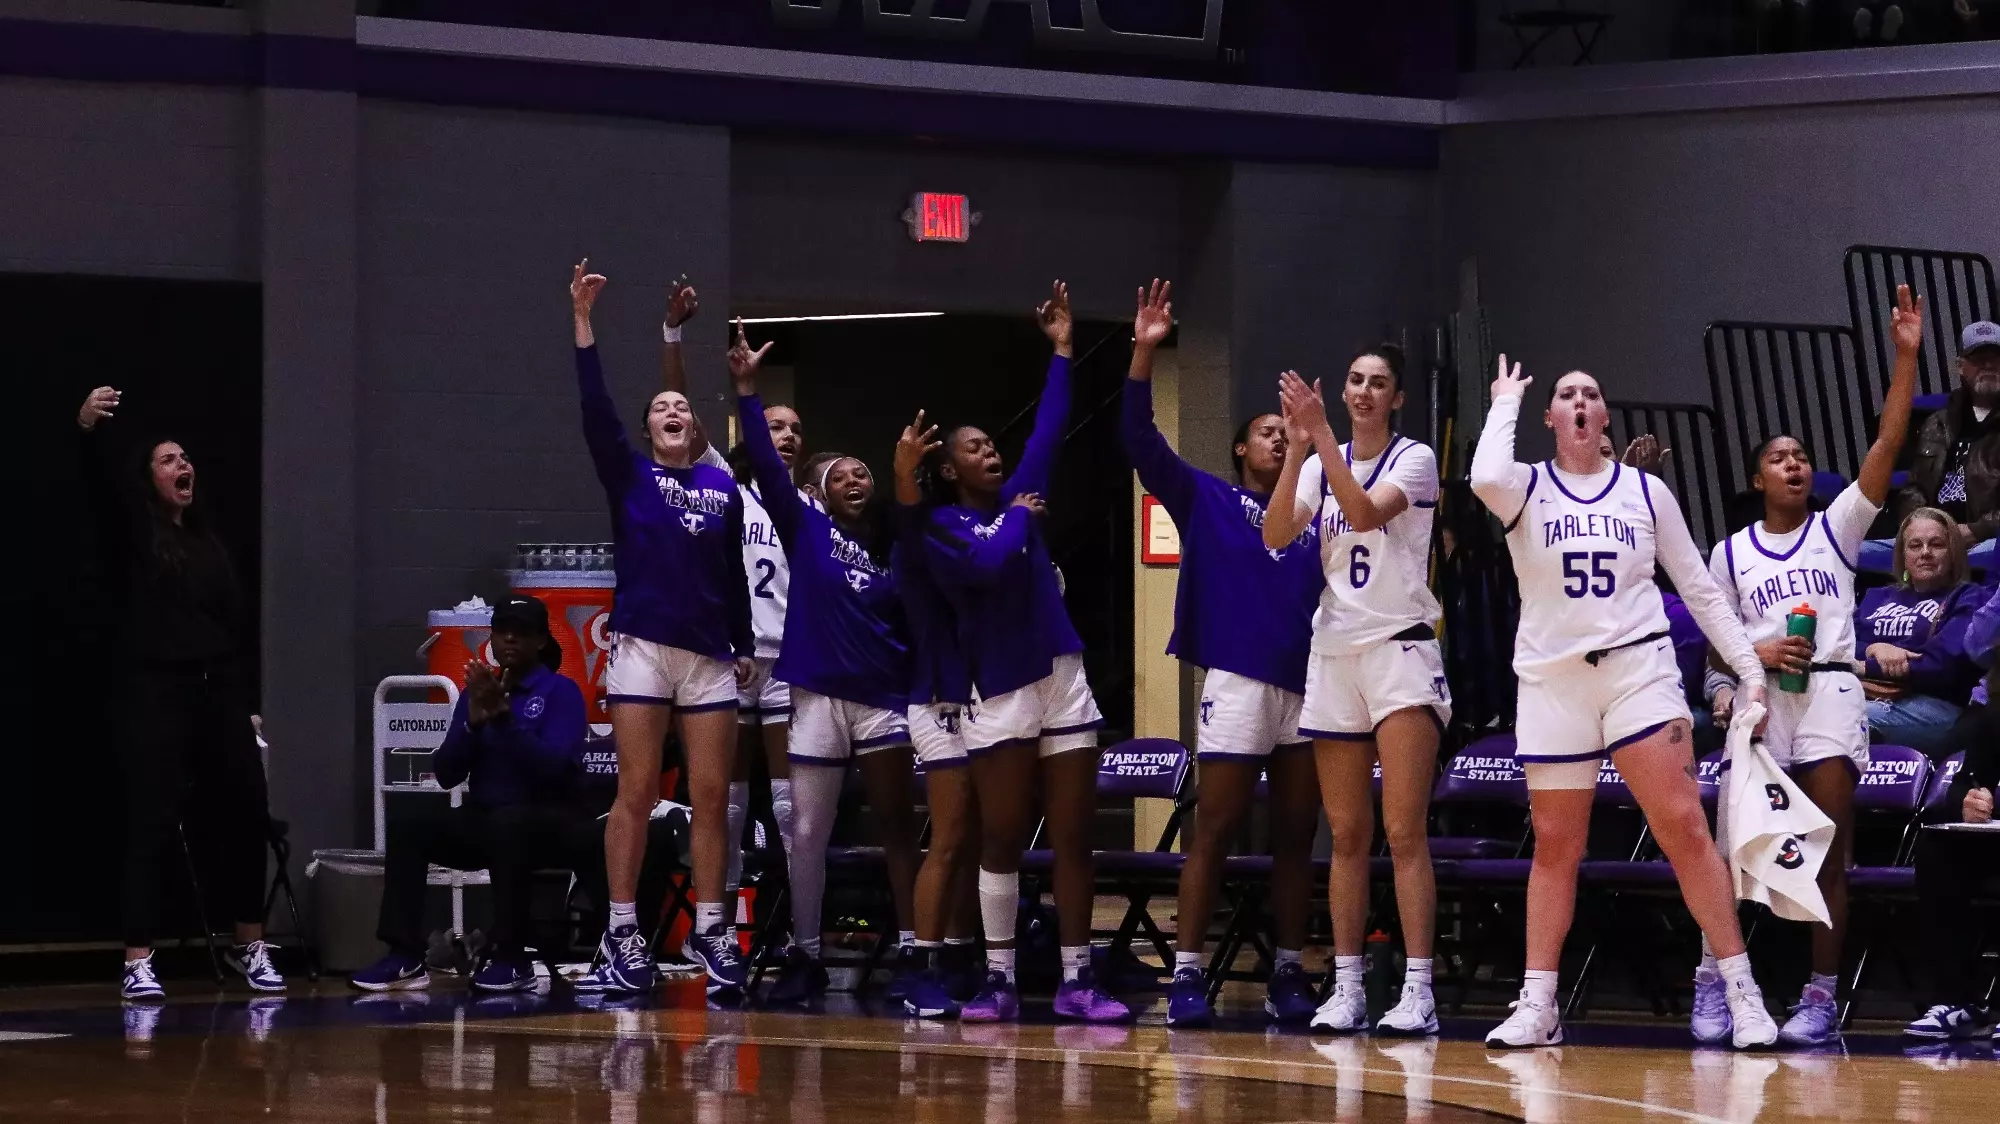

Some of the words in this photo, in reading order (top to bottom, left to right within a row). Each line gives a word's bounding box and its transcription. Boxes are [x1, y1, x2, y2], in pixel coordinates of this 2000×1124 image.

[924, 192, 964, 239] EXIT
[1543, 513, 1636, 551] TARLETON
[1349, 544, 1371, 590] 6
[1562, 551, 1618, 598] 55
[754, 557, 776, 599] 2
[1749, 568, 1840, 618] TARLETON
[1873, 615, 1918, 637] STATE
[388, 719, 447, 732] GATORADE
[586, 763, 619, 774] STAT
[1102, 752, 1180, 767] TARLETON
[1866, 760, 1920, 776] LETON
[1116, 765, 1160, 776] STATE
[1467, 769, 1514, 781] STATE
[1858, 773, 1898, 785] TATE
